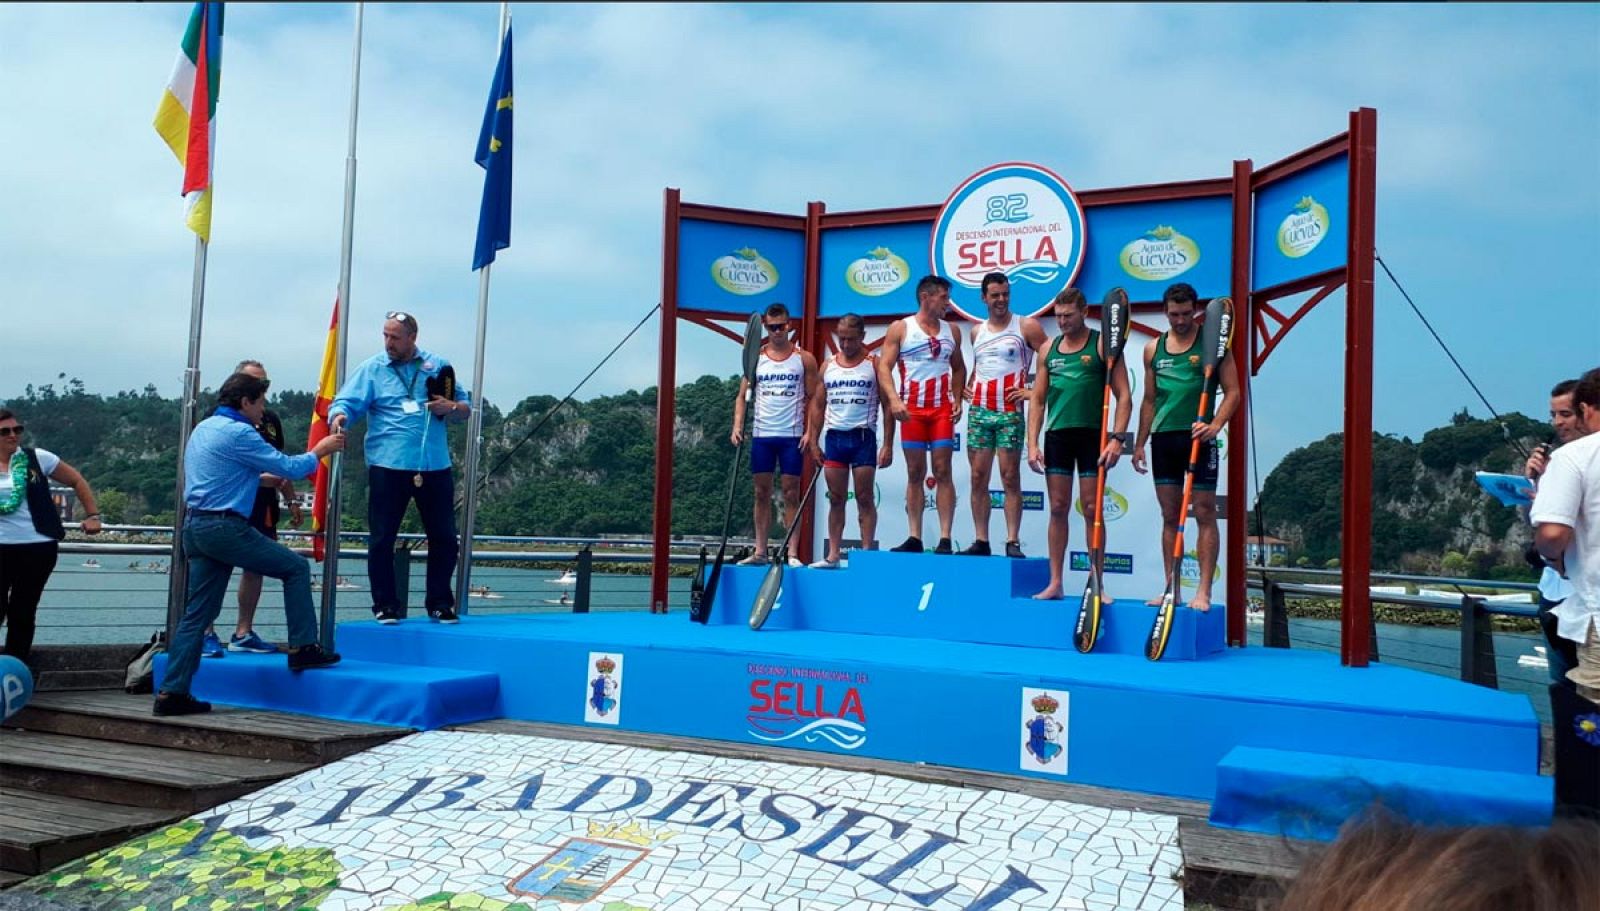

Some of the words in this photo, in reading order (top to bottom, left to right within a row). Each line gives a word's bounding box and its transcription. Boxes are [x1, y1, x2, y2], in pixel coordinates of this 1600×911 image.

[986, 193, 1029, 221] 82
[956, 229, 992, 240] DESCENSO
[993, 225, 1047, 237] INTERNACIONAL
[1048, 223, 1062, 232] DEL
[958, 235, 1059, 269] SELLA
[918, 582, 934, 611] 1
[748, 663, 788, 676] DESCENSO
[0, 673, 24, 718] P
[749, 679, 866, 723] SELLA
